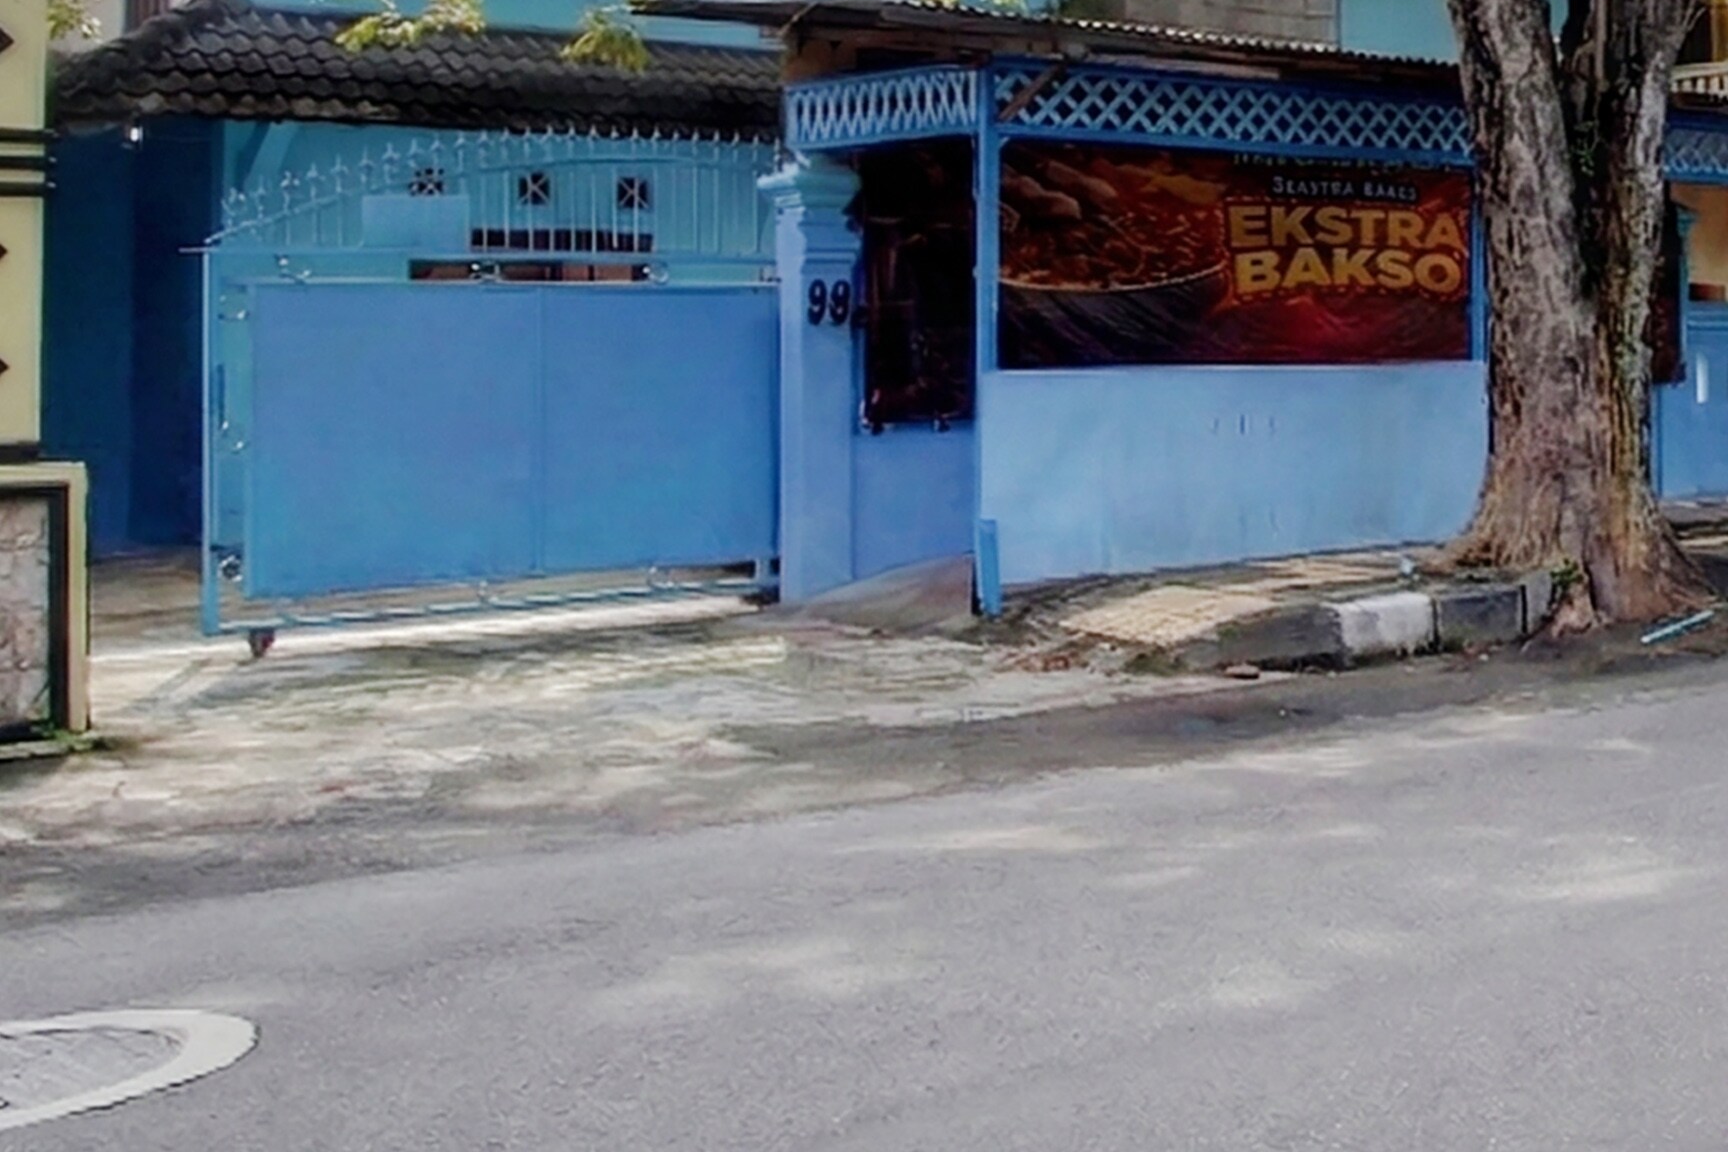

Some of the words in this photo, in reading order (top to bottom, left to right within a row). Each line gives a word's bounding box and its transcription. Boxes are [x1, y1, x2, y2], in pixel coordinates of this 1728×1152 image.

[1227, 204, 1467, 249] EKSTRA
[1234, 247, 1462, 294] BAKSO
[807, 278, 851, 327] 99
